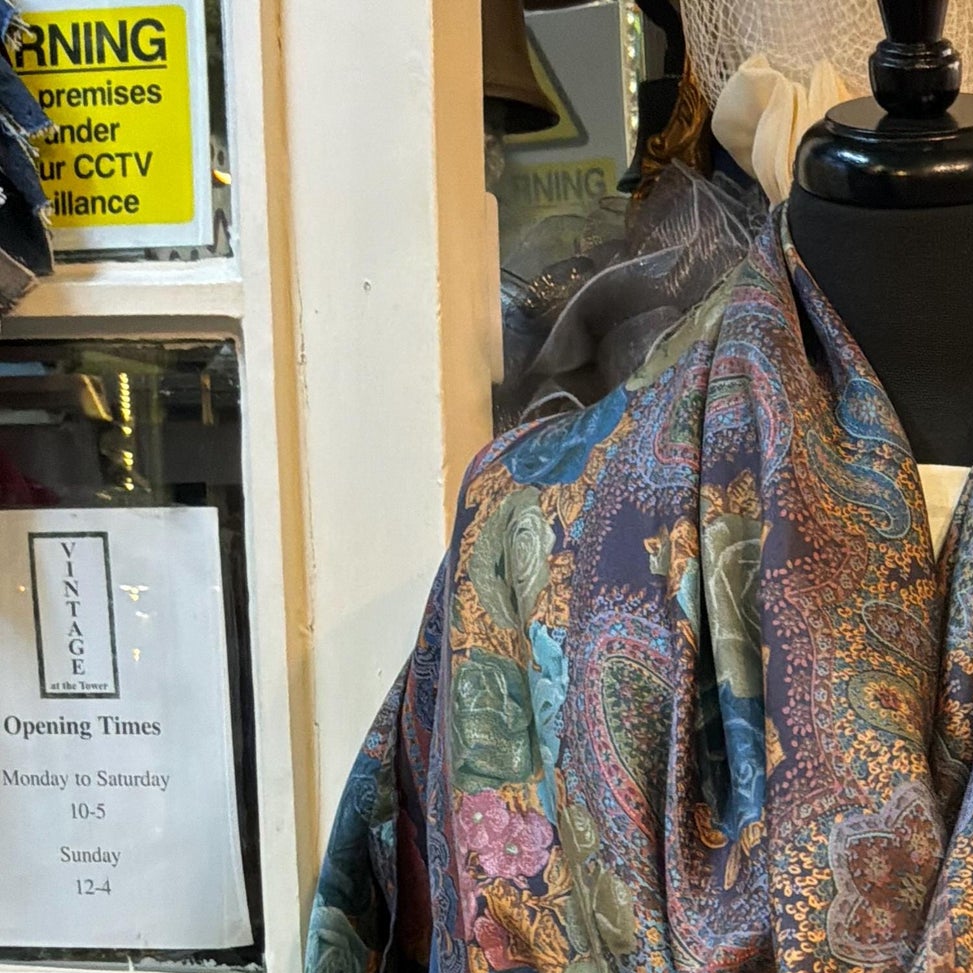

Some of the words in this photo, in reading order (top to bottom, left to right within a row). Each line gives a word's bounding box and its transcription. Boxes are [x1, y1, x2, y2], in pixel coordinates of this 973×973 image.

[0, 18, 167, 67] RNING
[38, 79, 162, 108] premises
[39, 161, 66, 181] ur
[73, 151, 153, 179] CCTV
[53, 191, 140, 216] illance
[60, 541, 86, 676] VINTAGE
[51, 682, 61, 690] at
[62, 681, 77, 690] the
[79, 681, 108, 691] Tower
[3, 715, 92, 740] Opening
[97, 715, 162, 736] Times
[2, 769, 69, 791] Monday
[75, 773, 91, 787] to
[97, 769, 170, 792] Saturday
[71, 802, 106, 819] 10-5
[60, 846, 121, 868] Sunday
[76, 876, 112, 895] 12-4
